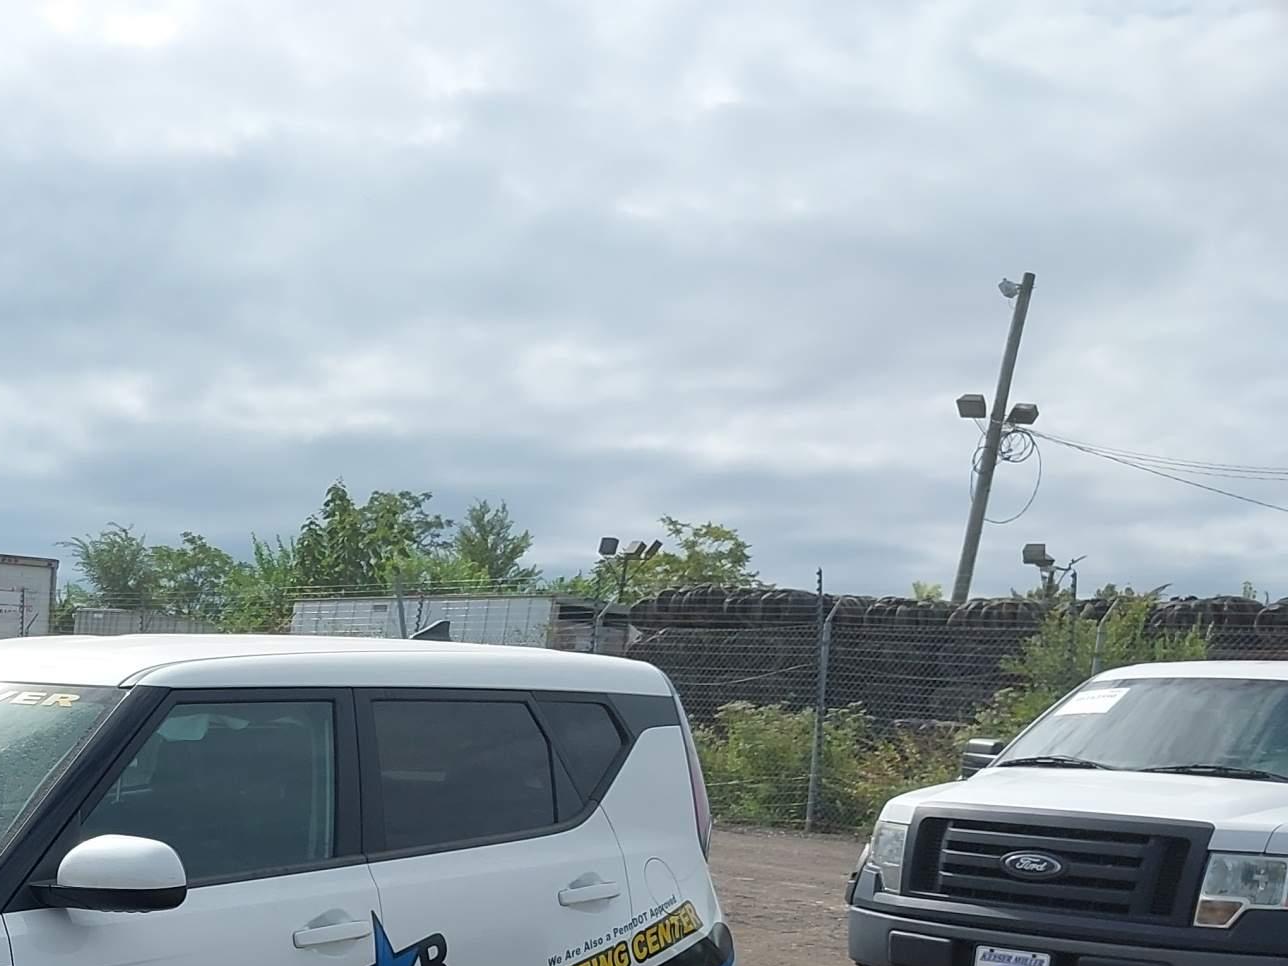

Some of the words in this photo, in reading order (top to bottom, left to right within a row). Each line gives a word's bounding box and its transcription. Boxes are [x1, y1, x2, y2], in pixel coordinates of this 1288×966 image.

[1015, 857, 1048, 872] Ford
[565, 947, 581, 961] Are
[584, 937, 604, 952] Also
[606, 934, 612, 942] a
[613, 912, 649, 938] PennDOT
[650, 896, 678, 919] Approved
[632, 900, 704, 963] CENTER
